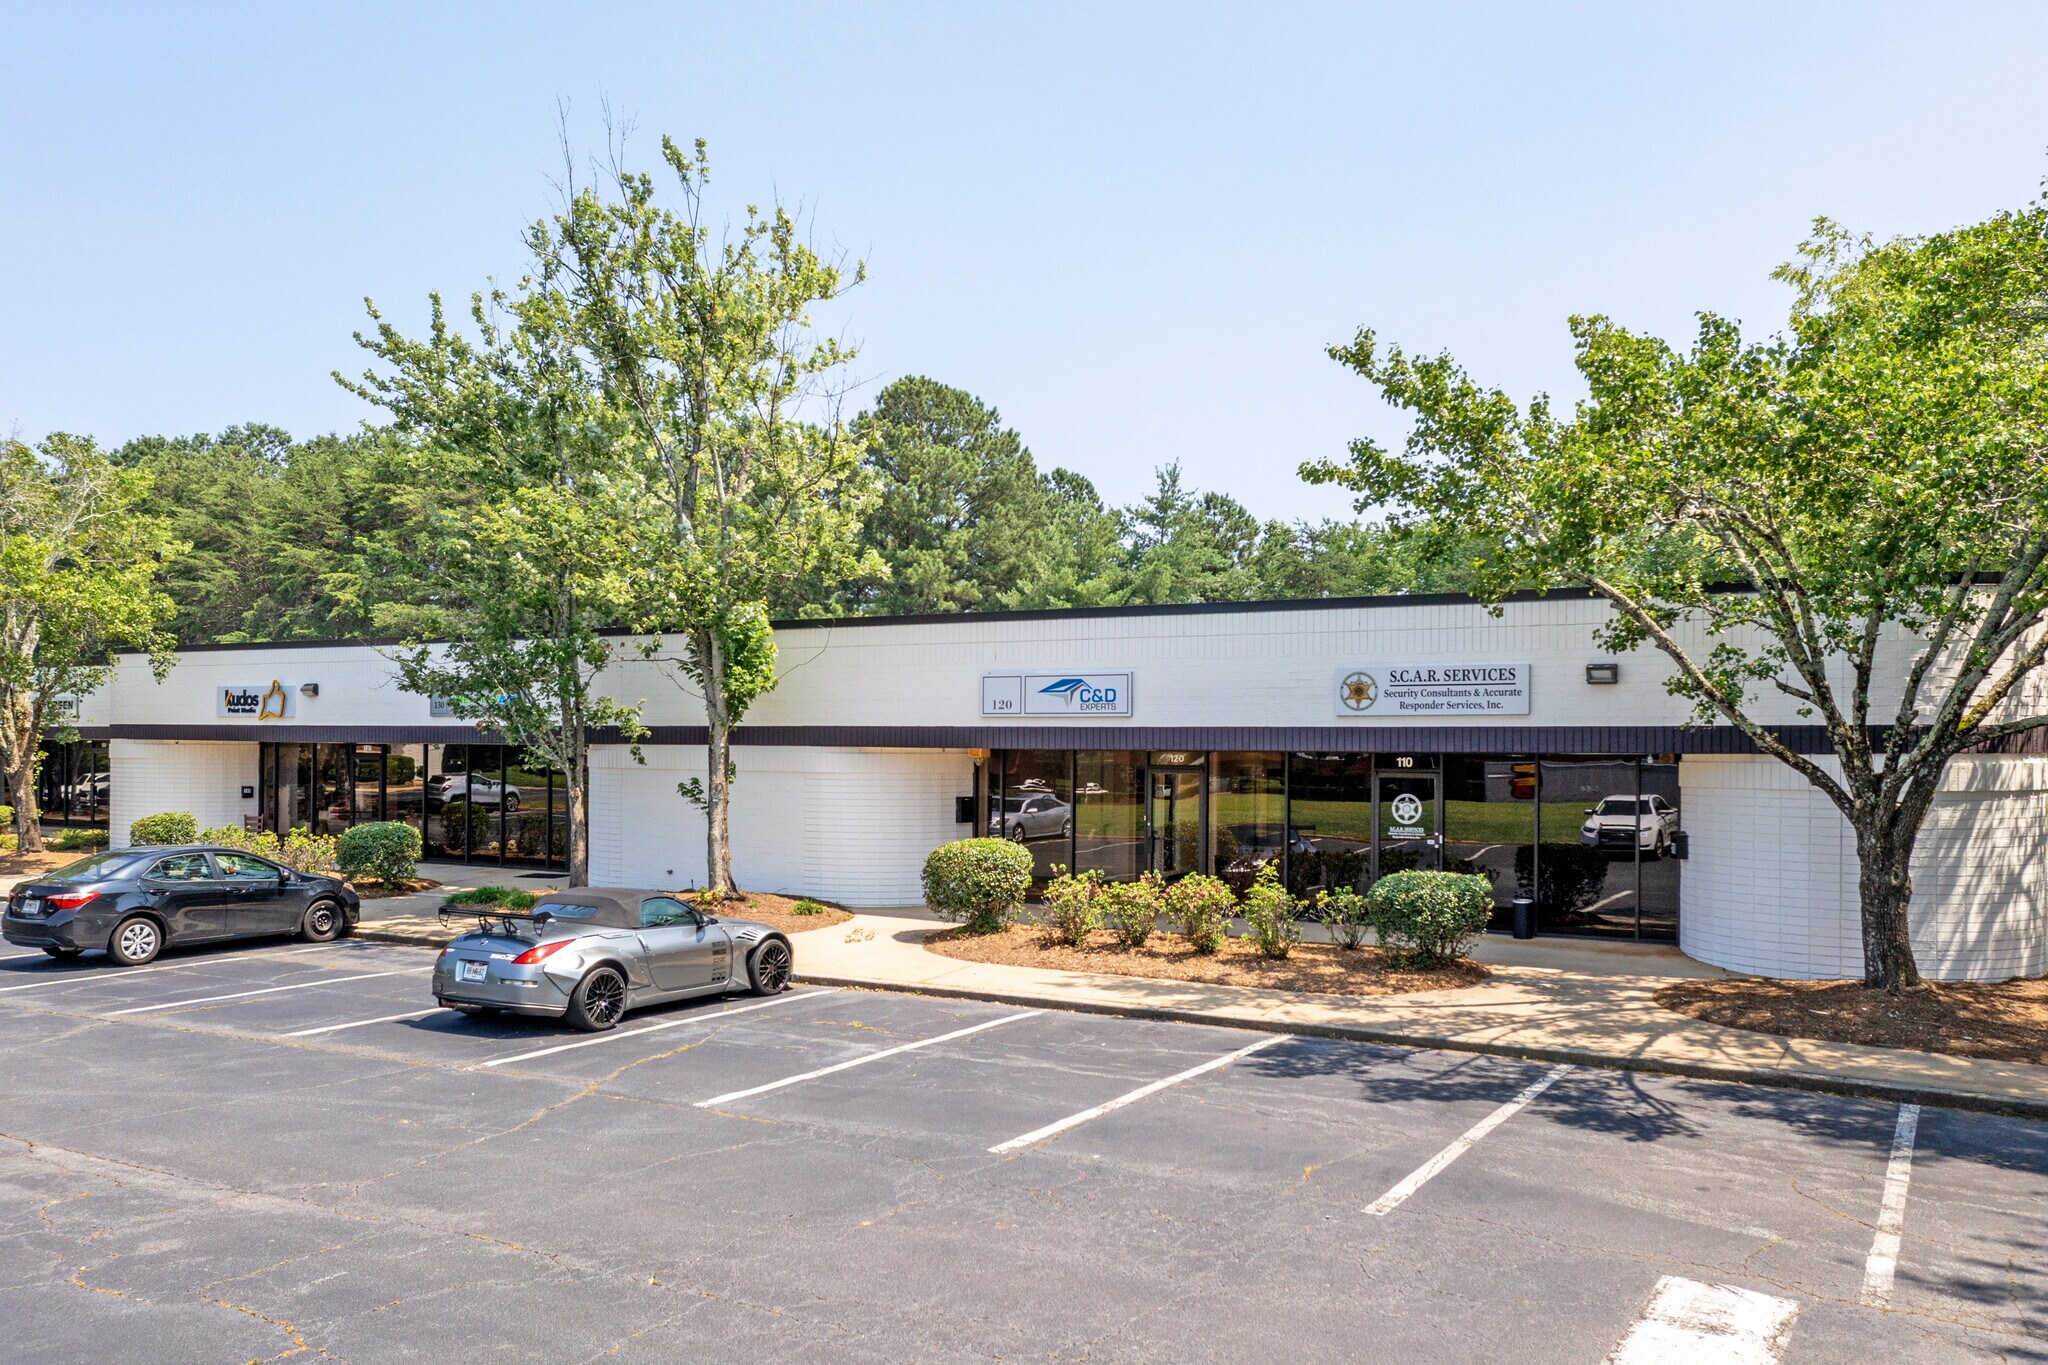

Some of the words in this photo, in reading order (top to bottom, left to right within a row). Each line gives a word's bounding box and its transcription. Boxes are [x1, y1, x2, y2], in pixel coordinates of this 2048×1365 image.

[1389, 669, 1440, 683] S.C.A.R.
[1443, 668, 1516, 682] SERVICES
[1079, 688, 1117, 703] C&D
[1383, 688, 1419, 699] Security
[1420, 688, 1472, 698] Consultants
[1473, 689, 1481, 697] &
[1482, 688, 1522, 697] Accurate
[434, 701, 445, 710] 130
[992, 699, 1013, 710] 120
[1080, 702, 1117, 711] EXPERTS
[1399, 700, 1445, 711] Responder
[1446, 700, 1485, 711] Services,
[1486, 700, 1504, 710] Inc.
[1170, 754, 1185, 763] 120
[1396, 757, 1413, 768] 110
